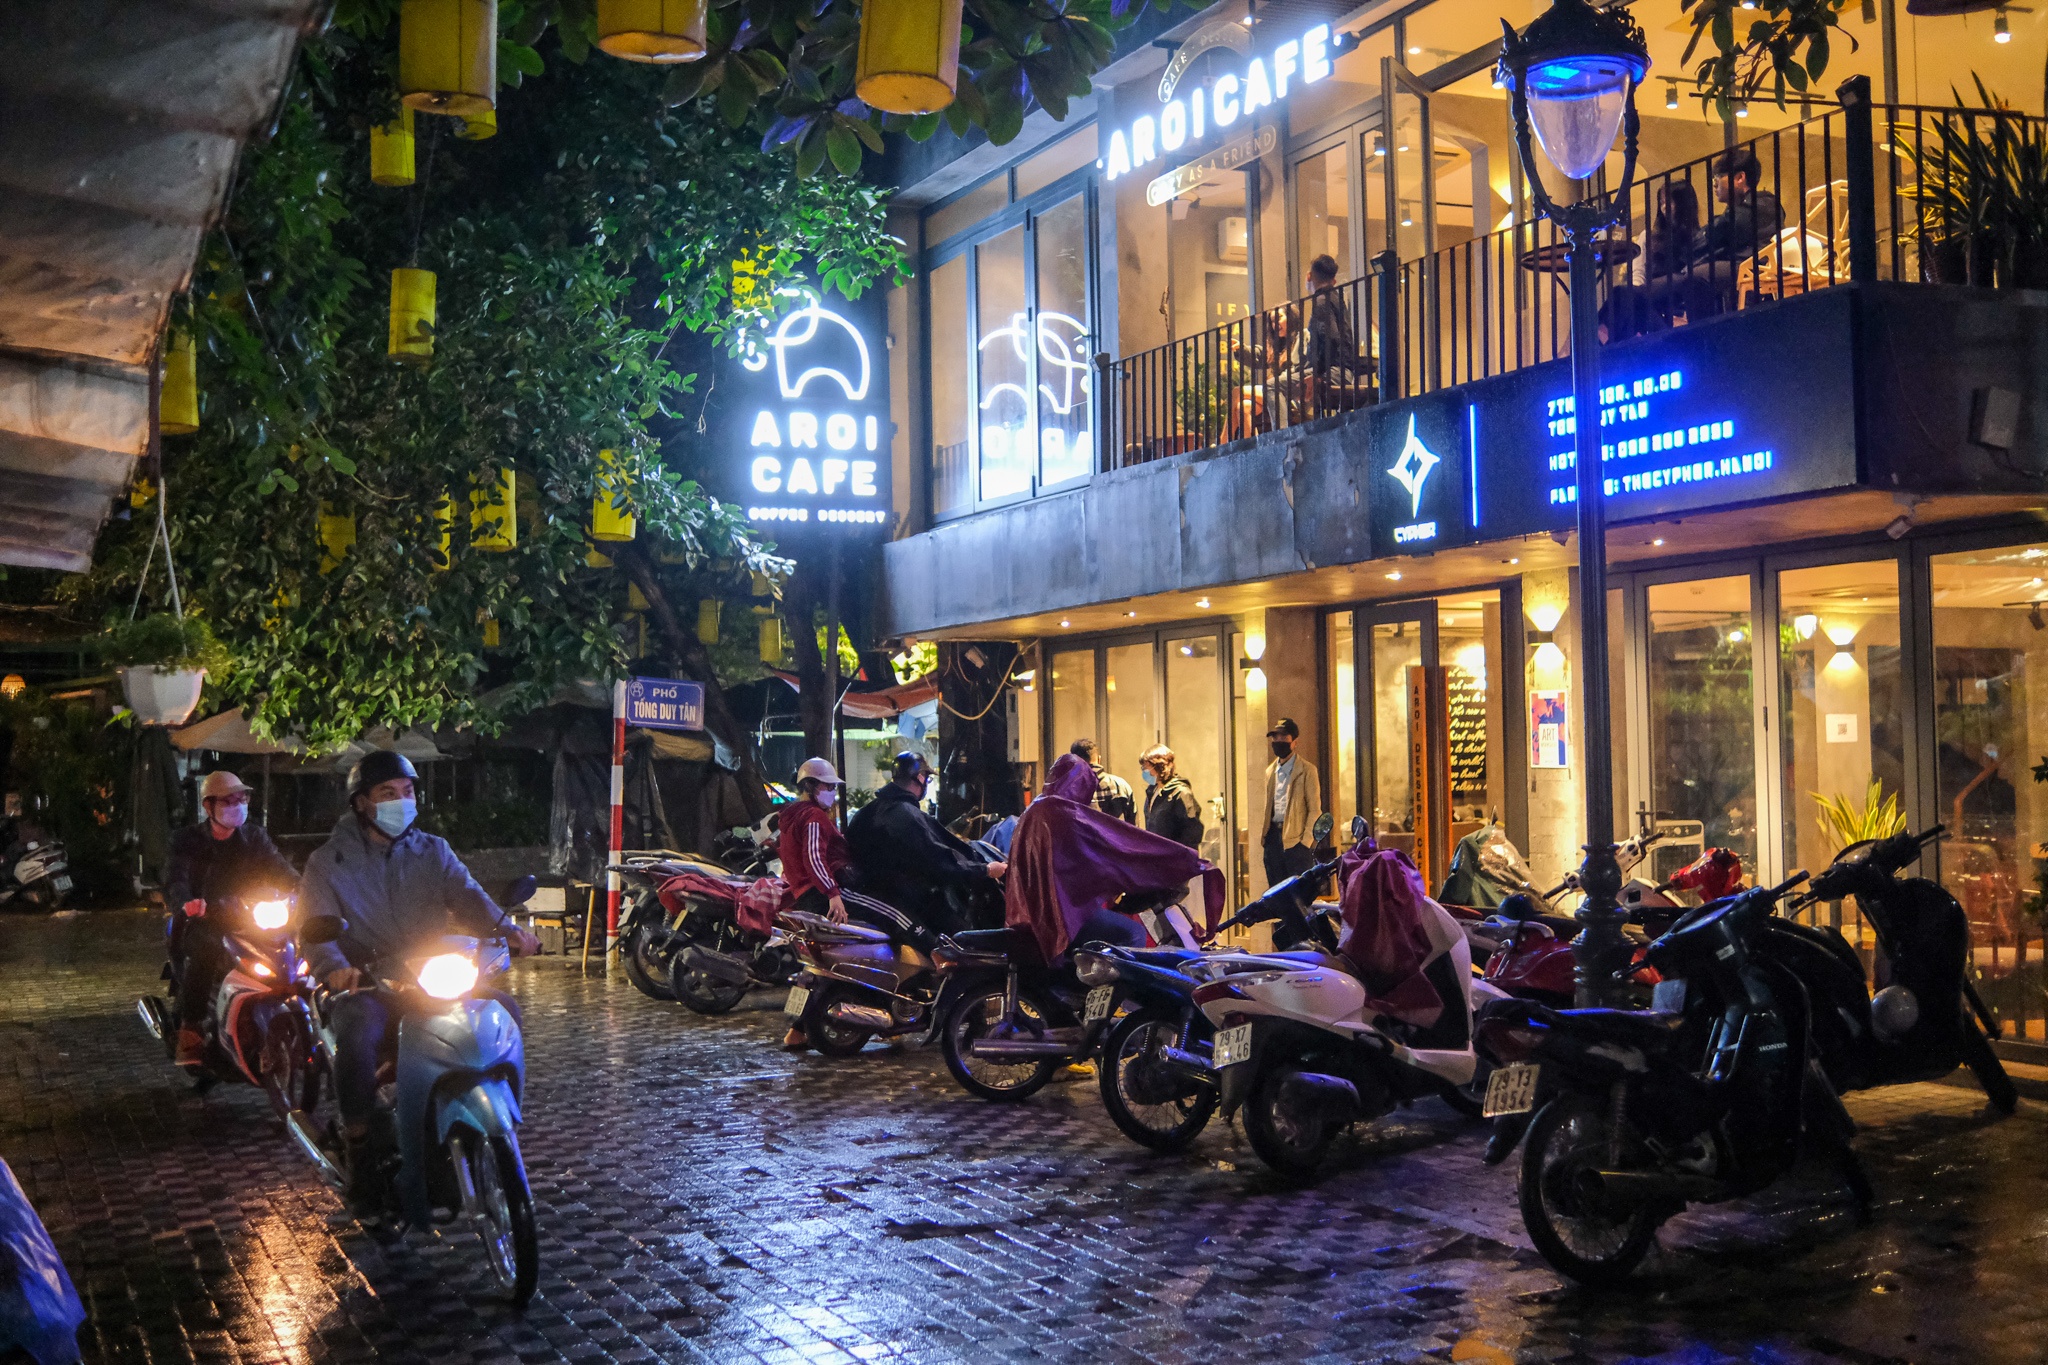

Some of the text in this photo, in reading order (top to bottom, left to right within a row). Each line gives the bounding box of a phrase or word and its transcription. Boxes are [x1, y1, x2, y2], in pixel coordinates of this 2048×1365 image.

[1189, 164, 1203, 183] AS
[1210, 159, 1217, 172] A
[1223, 133, 1272, 167] FRIEND
[750, 410, 878, 452] AROI
[750, 456, 878, 497] CAFE
[634, 696, 697, 722] TỐNG DUY TÂN
[652, 686, 678, 699] PHỐ
[1542, 727, 1556, 741] ART
[1413, 685, 1424, 872] AROI DESSERT CAF
[1758, 1042, 1788, 1052] HONDA
